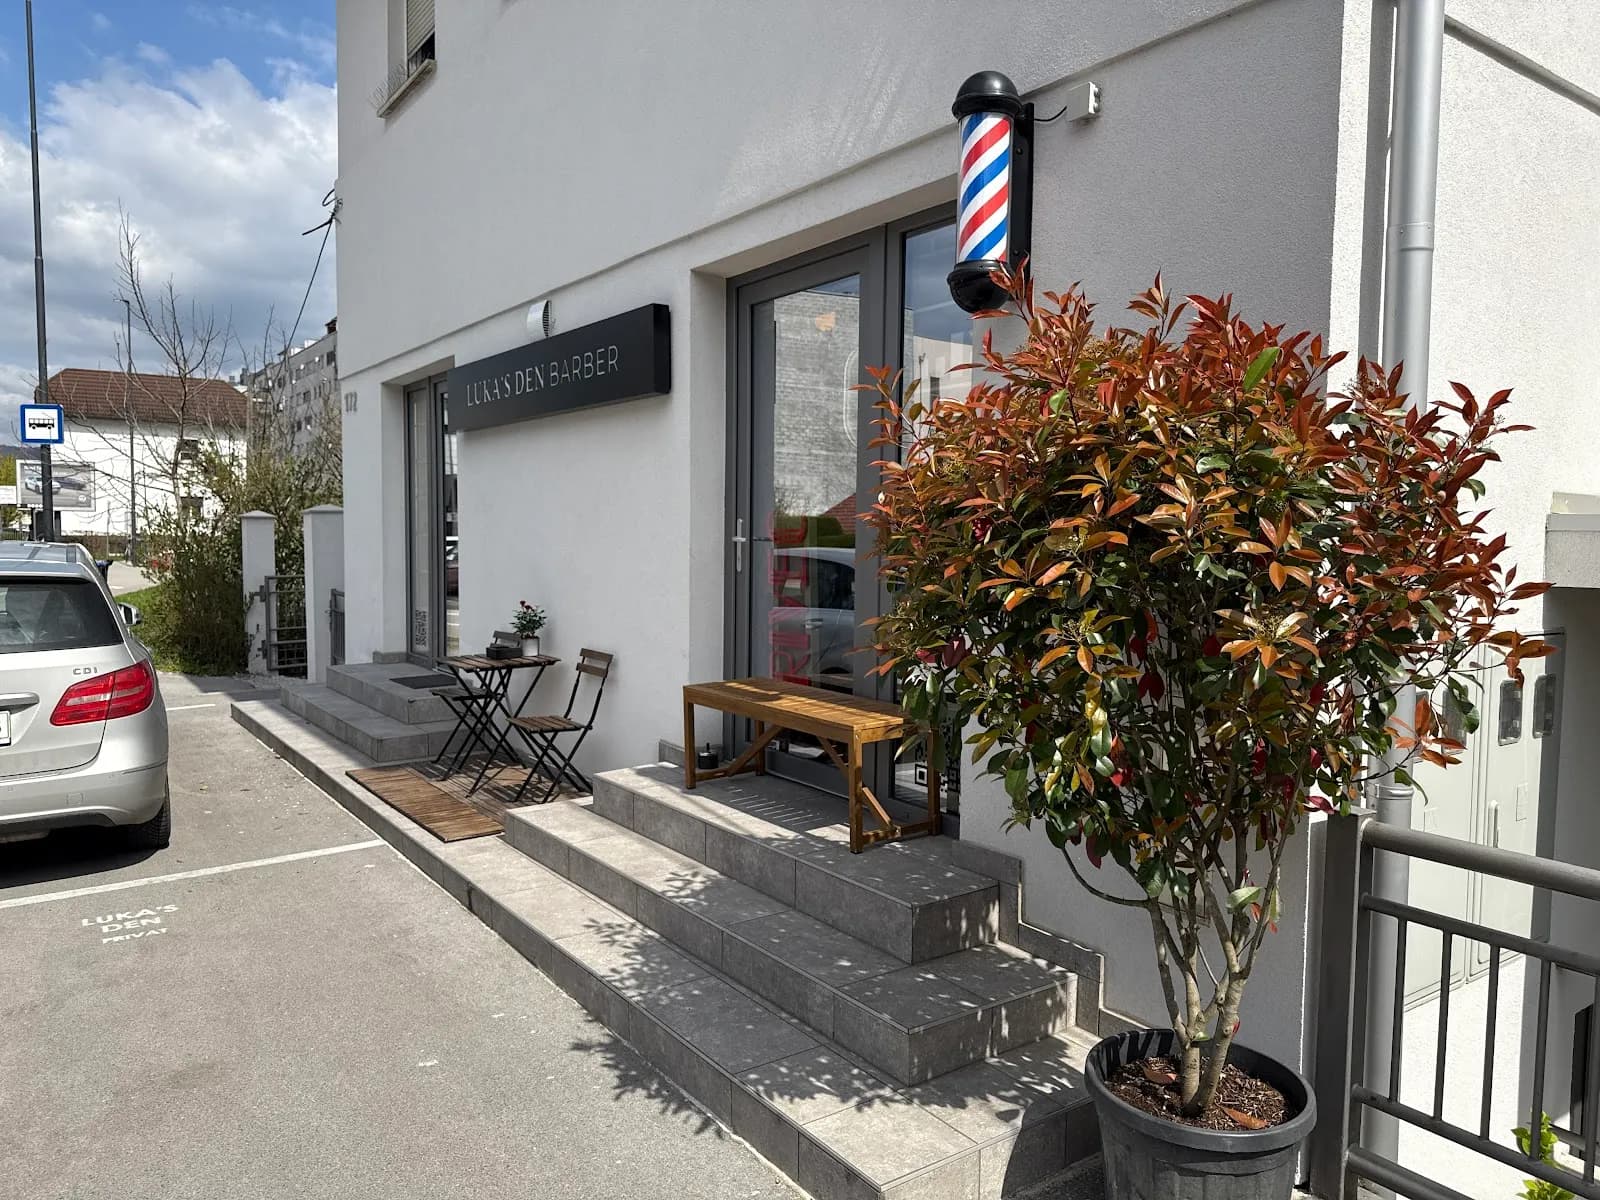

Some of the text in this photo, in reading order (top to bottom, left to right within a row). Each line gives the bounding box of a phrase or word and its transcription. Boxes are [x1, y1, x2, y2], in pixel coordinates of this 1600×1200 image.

[466, 345, 619, 407] LUKA'S DEN BARBER
[73, 666, 98, 676] CDI
[82, 904, 179, 926] LUKA'S
[102, 916, 161, 933] DEN
